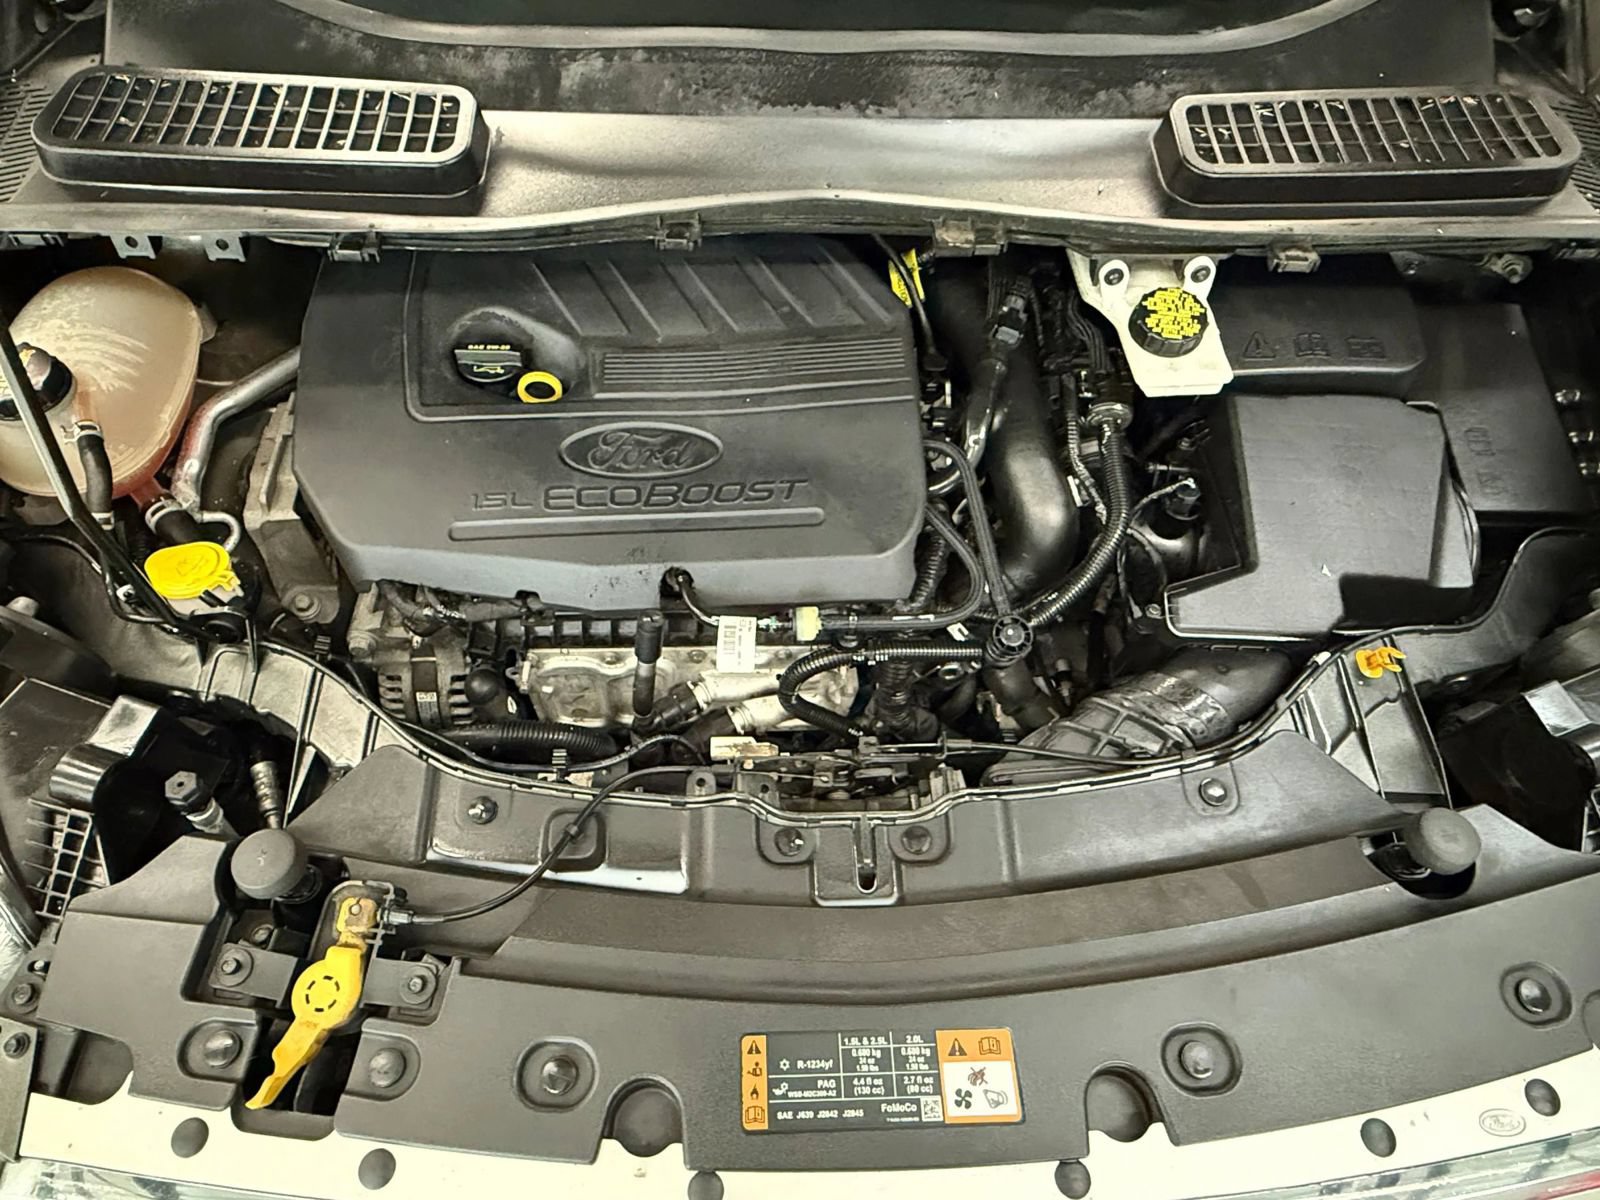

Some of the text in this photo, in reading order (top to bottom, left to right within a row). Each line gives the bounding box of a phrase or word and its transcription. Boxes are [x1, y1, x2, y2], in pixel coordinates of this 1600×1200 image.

[588, 430, 696, 470] Ford
[544, 479, 809, 512] ECOBOOST
[906, 1034, 924, 1043] 2.0L
[797, 1059, 834, 1070] R-1234yf
[817, 1079, 836, 1089] PAG
[853, 1077, 865, 1085] 4.4
[903, 1076, 915, 1084] 2.7
[923, 1076, 934, 1084] oz
[854, 1086, 885, 1096] (130 cc)
[920, 1084, 933, 1094] cc)
[881, 1102, 918, 1113] FoMoCo
[777, 1111, 793, 1120] SAE
